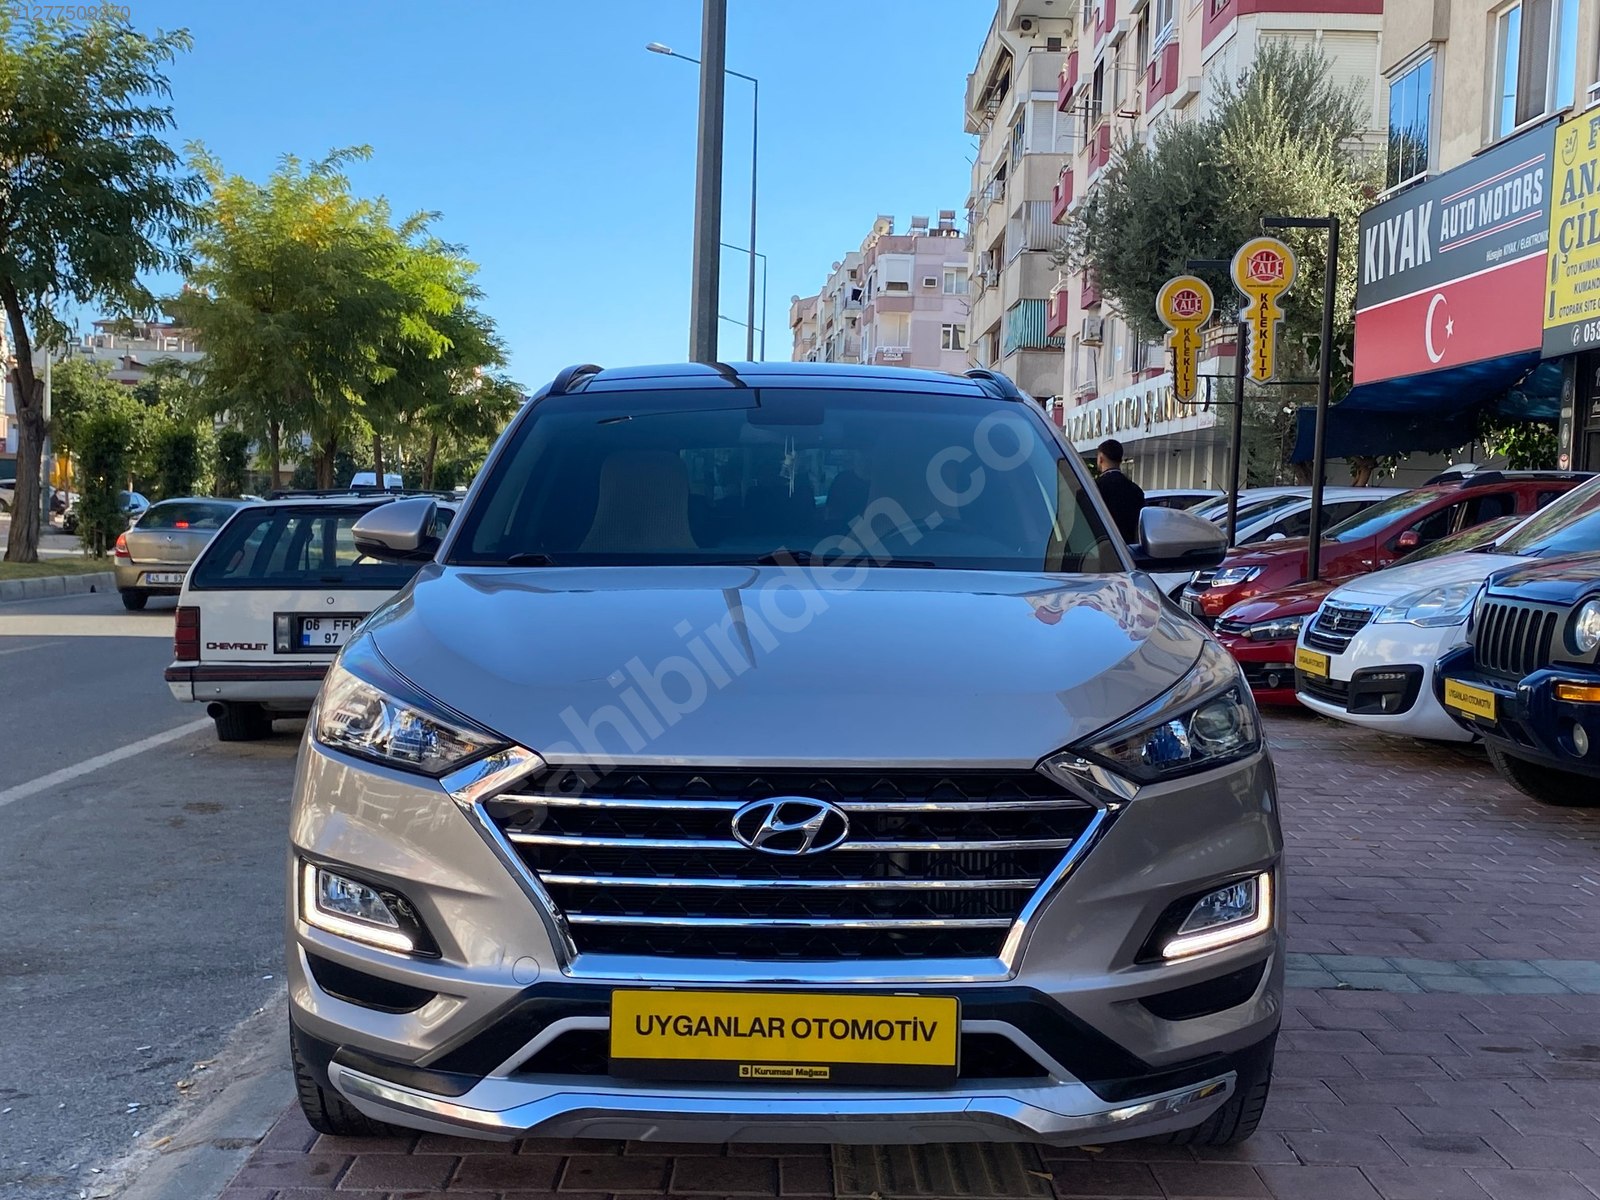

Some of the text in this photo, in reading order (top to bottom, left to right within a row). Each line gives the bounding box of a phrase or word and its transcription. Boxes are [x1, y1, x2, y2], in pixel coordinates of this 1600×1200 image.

[1560, 158, 1600, 205] AN
[1364, 168, 1543, 285] KIYAK AUTO MOTORS
[1247, 259, 1284, 277] KALE
[1171, 297, 1202, 314] KALE
[305, 619, 358, 631] 06 FFK
[206, 642, 268, 650] CHEVROLET
[324, 632, 338, 644] 97
[635, 1014, 938, 1042] UYGANLAR OTOMOTİV
[754, 1067, 793, 1076] Kurumsal
[796, 1068, 828, 1078] Mağaza
